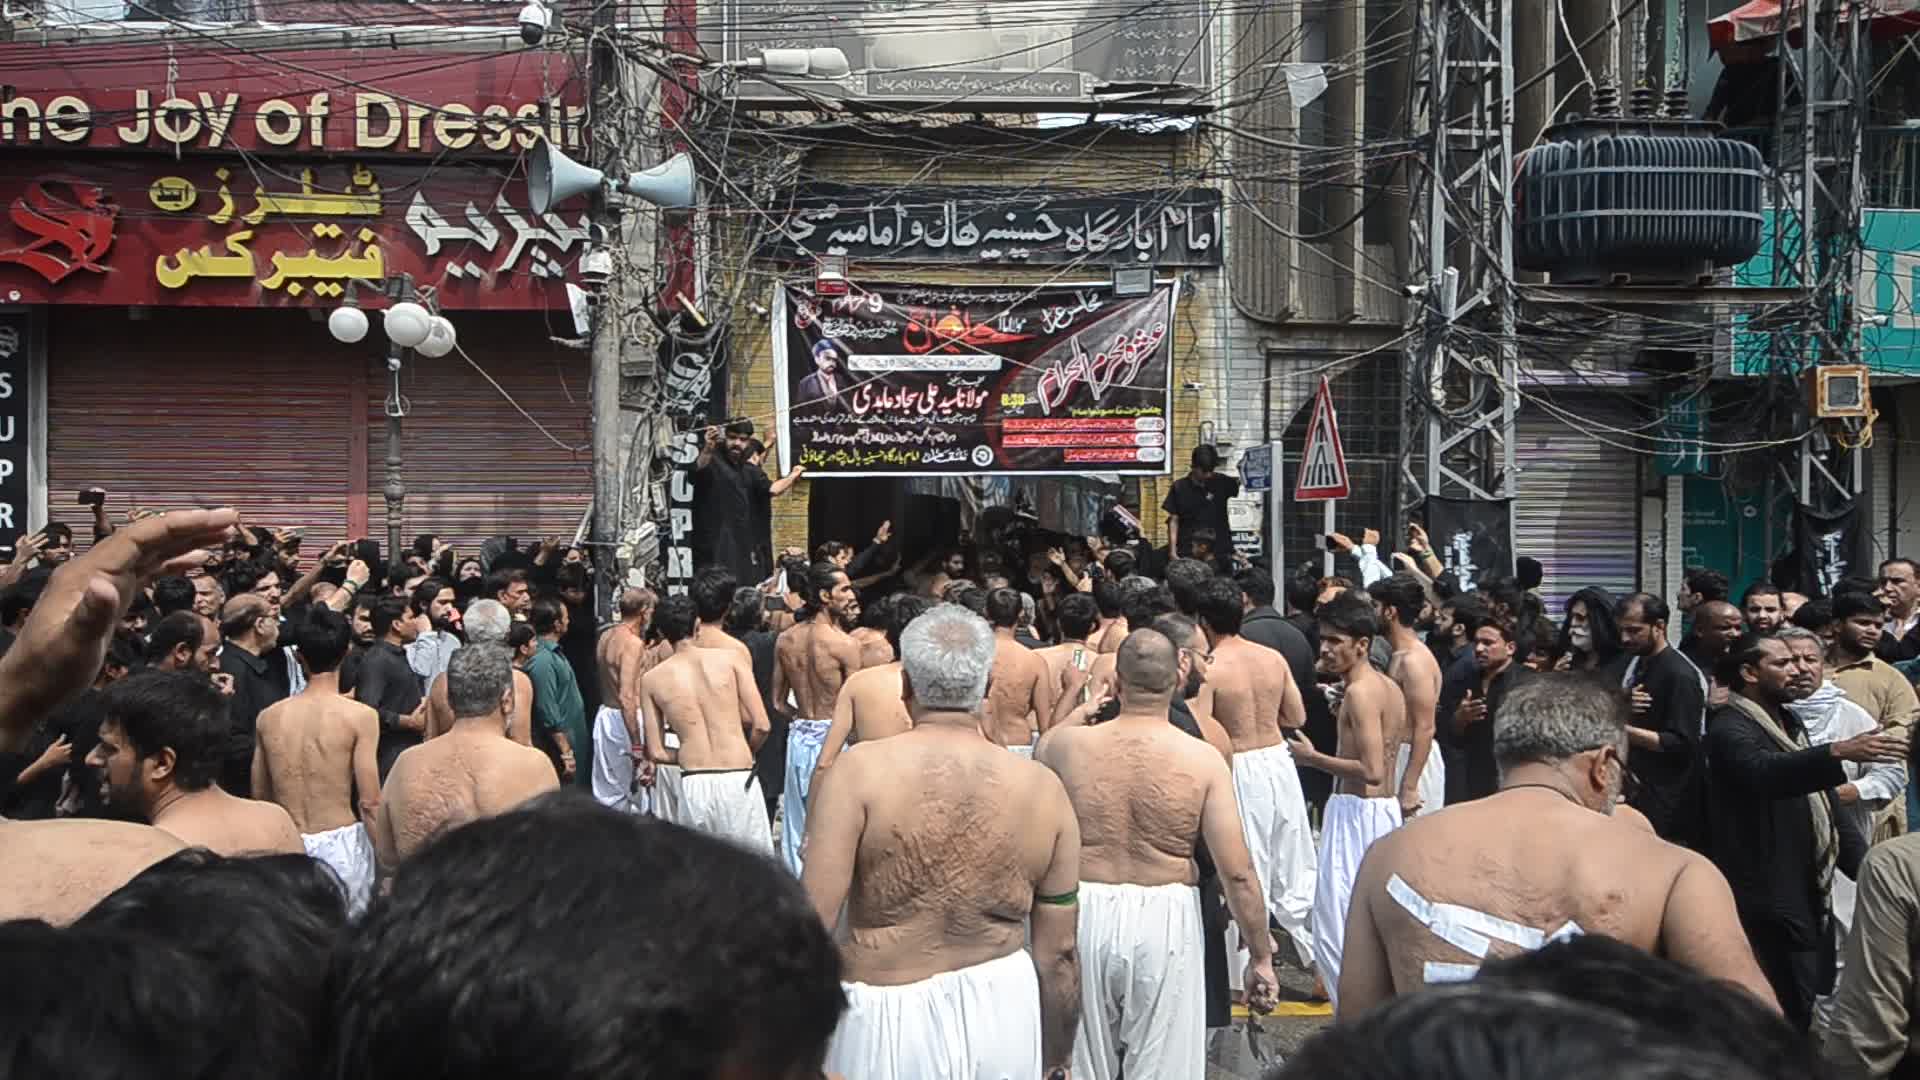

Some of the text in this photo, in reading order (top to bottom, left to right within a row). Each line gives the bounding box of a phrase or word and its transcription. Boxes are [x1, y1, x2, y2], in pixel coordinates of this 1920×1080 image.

[0, 89, 586, 149] he Joy of Dressi
[405, 191, 591, 278] پریم
[1159, 203, 1221, 251] امام
[667, 431, 699, 597] SUPR
